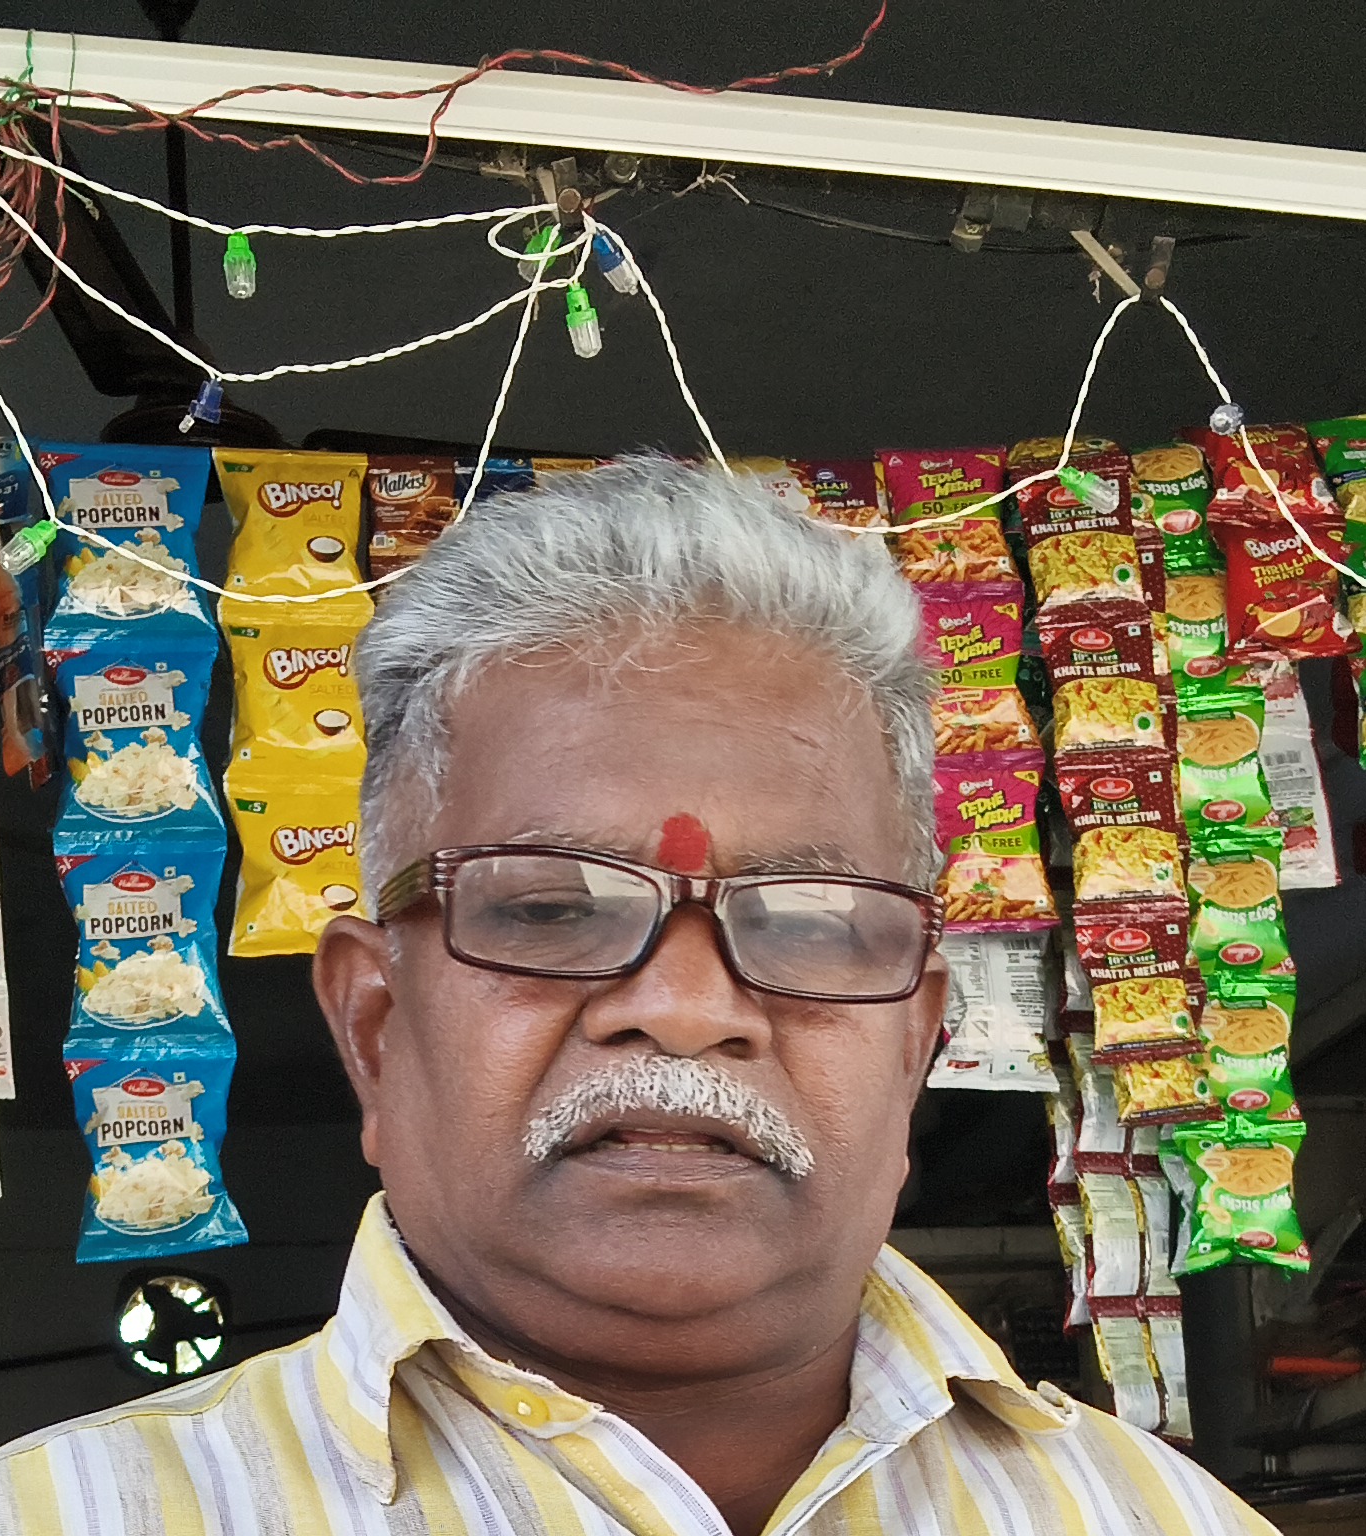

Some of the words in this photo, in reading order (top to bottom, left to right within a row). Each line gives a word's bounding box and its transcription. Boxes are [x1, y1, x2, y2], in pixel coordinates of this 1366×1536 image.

[375, 470, 429, 494] Malkist
[918, 468, 964, 488] TEDHE
[934, 478, 982, 498] MEDHE
[1138, 479, 1179, 496] Sticks
[1178, 474, 1209, 492] Soya
[93, 493, 143, 507] SALTED
[264, 480, 343, 508] BINGO!
[77, 506, 161, 525] POPCORN
[1031, 520, 1073, 536] KHATTA
[1075, 515, 1120, 531] MEETHA
[1244, 536, 1303, 560] BINGO!
[1254, 567, 1305, 589] TOMATO
[937, 625, 984, 652] TEDHE
[953, 639, 1002, 663] MEDHE
[269, 645, 351, 684] BINGO!
[973, 667, 1003, 679] FREE
[1054, 665, 1096, 679] KHATTA
[1098, 661, 1141, 676] MEETHA
[99, 691, 149, 706] SALTED
[82, 704, 167, 726] POPCORN
[956, 792, 1005, 819] TEDHE
[973, 803, 1024, 830] MEDHE
[1073, 812, 1114, 827] KHATTA
[1116, 809, 1161, 825] MEETHA
[276, 824, 356, 858] BINGO!
[961, 835, 984, 850] 50
[992, 835, 1023, 849] FREE
[107, 901, 158, 915] SALTED
[1247, 905, 1278, 924] Soya
[90, 913, 174, 935] POPCORN
[1090, 965, 1131, 980] KHATTA
[1133, 959, 1179, 978] MEETHA
[1256, 1051, 1287, 1070] Soya
[116, 1105, 168, 1120] SALTED
[101, 1117, 185, 1140] POPCORN
